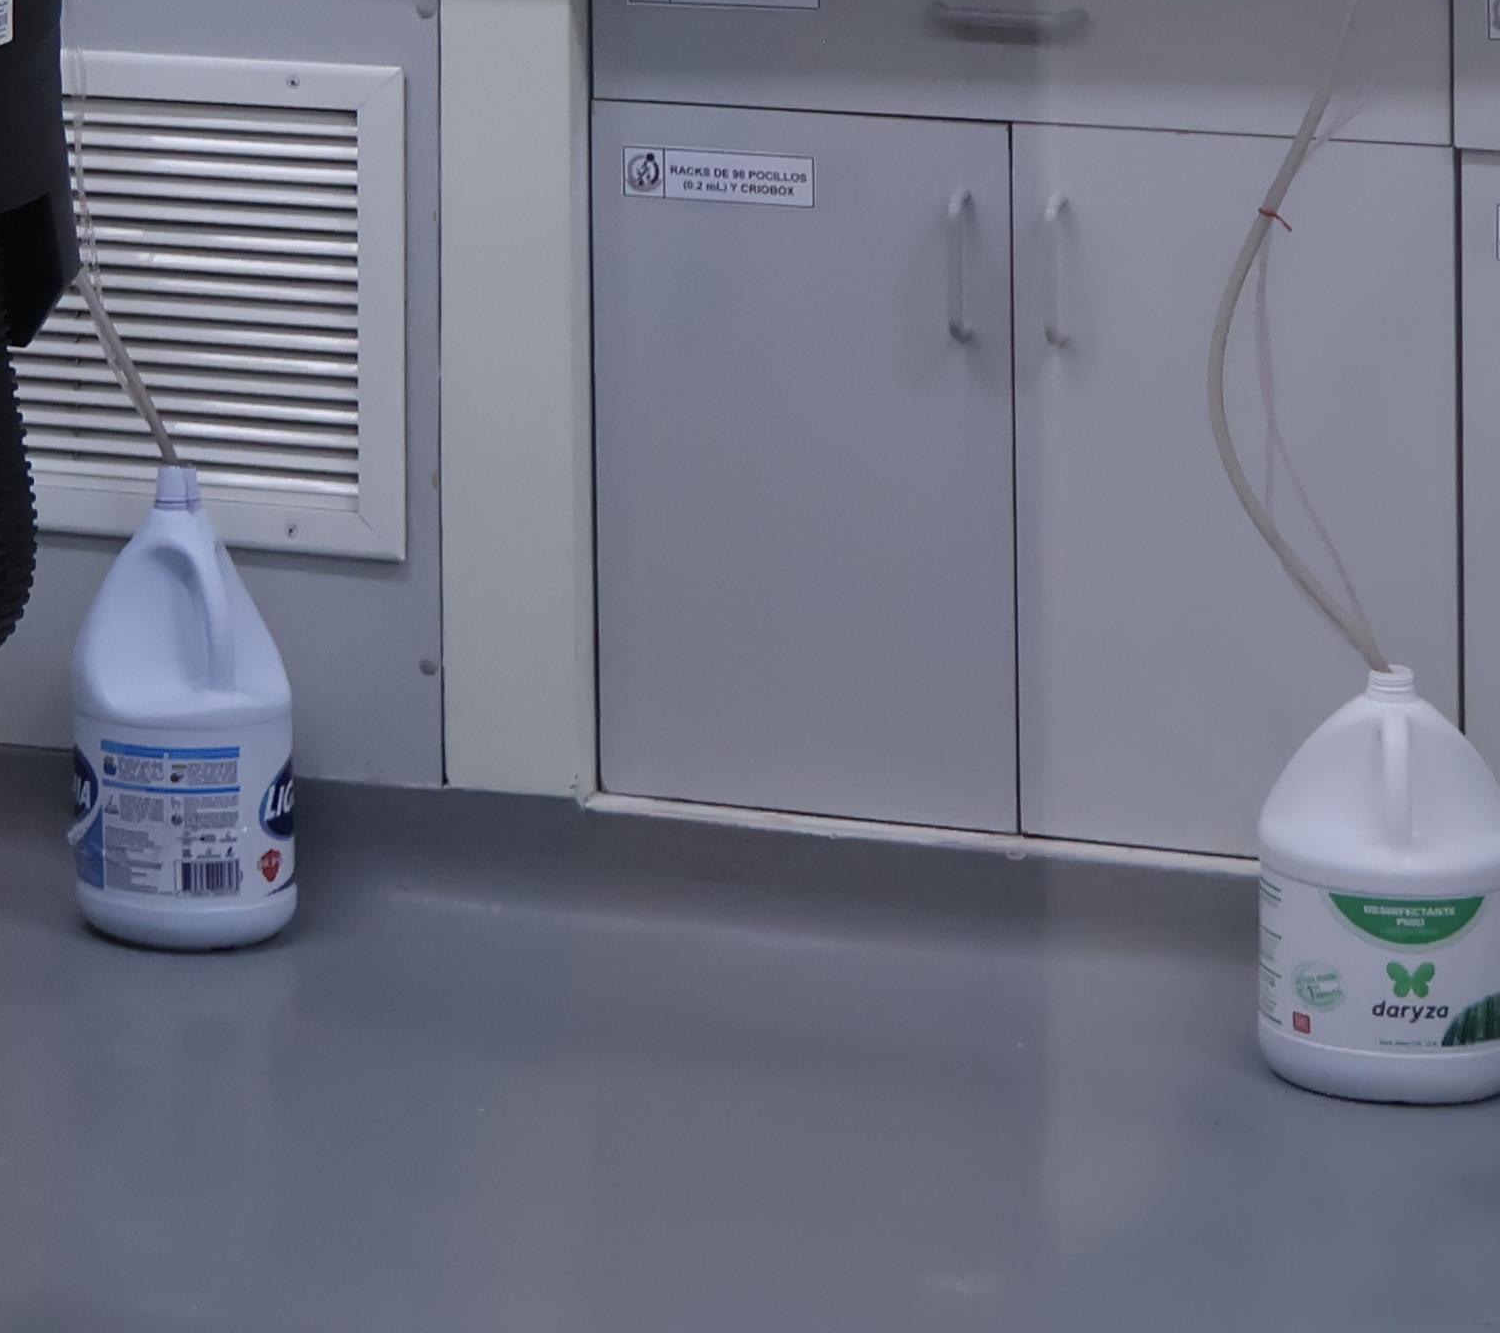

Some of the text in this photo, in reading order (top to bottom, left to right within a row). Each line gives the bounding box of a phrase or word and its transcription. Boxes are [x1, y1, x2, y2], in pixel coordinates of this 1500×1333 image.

[670, 165, 711, 177] RACKS
[713, 167, 729, 179] DE
[748, 170, 807, 183] POCILLOS
[730, 184, 738, 192] Y
[740, 184, 795, 197] CRIOBOX
[1371, 1000, 1450, 1023] daryza
